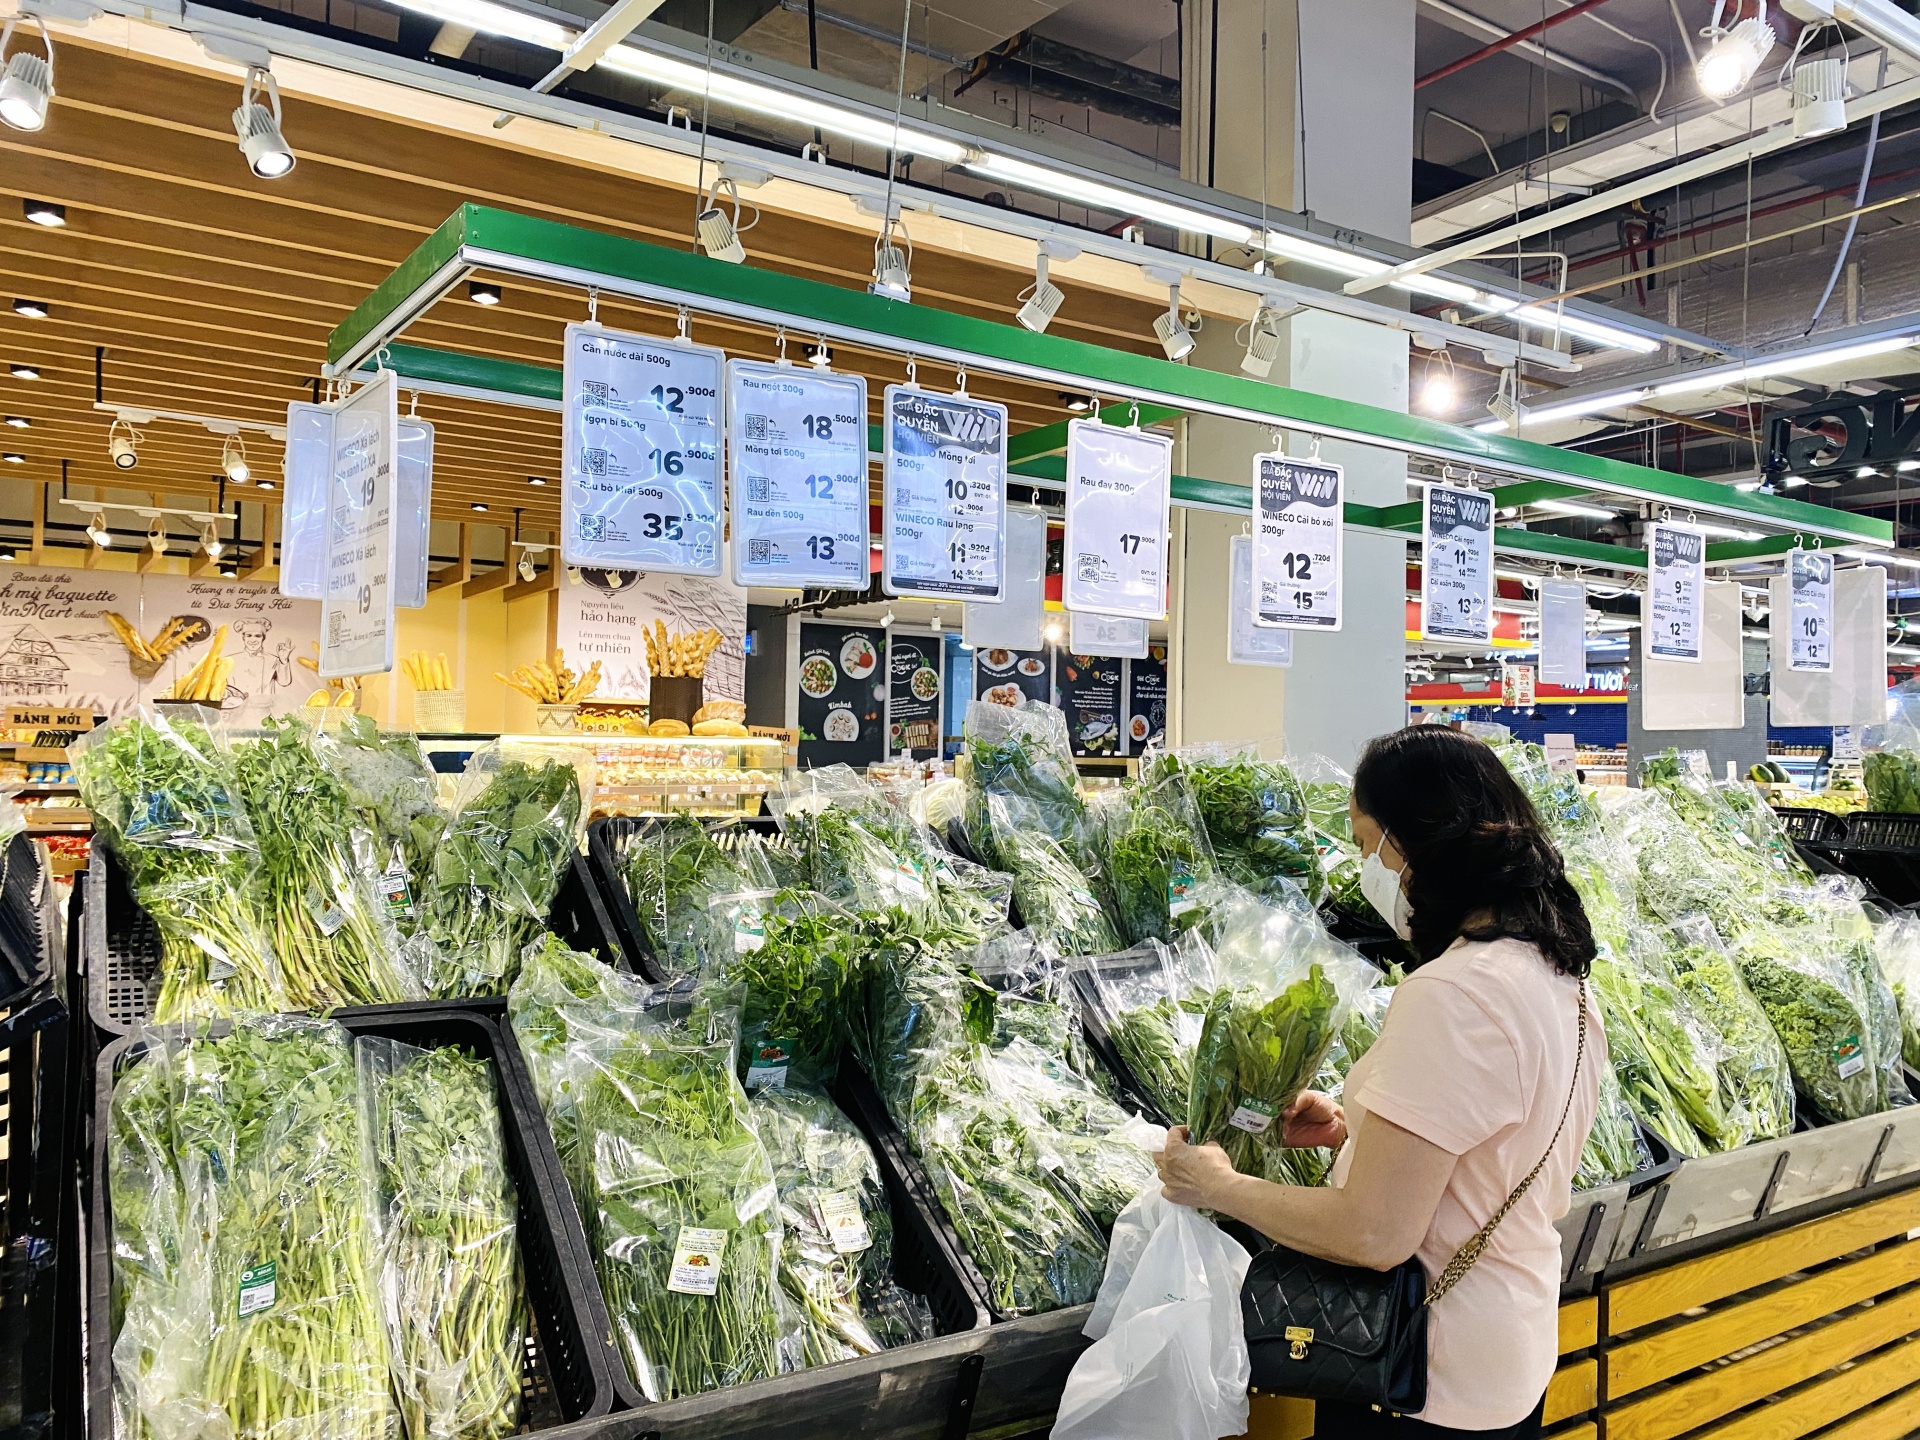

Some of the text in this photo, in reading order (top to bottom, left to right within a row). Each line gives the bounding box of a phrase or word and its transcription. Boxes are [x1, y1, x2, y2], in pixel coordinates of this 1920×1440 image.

[582, 343, 671, 368] Cần nước dài 500g
[743, 379, 804, 396] Rau ngót 300g
[610, 417, 618, 426] bí
[621, 419, 646, 431] 500g
[745, 443, 769, 456] Mồng
[783, 448, 805, 459] 500g
[938, 449, 963, 464] Mồng
[897, 458, 925, 471] 500gr
[1080, 476, 1096, 487] Rau
[1114, 482, 1135, 495] 300g
[1261, 476, 1292, 491] QUYỀN
[638, 488, 663, 500] 500g
[1261, 490, 1291, 501] HỘI VIÊN
[747, 508, 804, 521] Rau dền 500g
[895, 512, 974, 532] WINECO Rau lang
[1262, 511, 1295, 523] WINECO
[1296, 514, 1309, 524] Cải
[1322, 518, 1334, 527] xôi
[895, 527, 923, 540] 500gr
[1261, 524, 1285, 537] 300gr
[331, 550, 355, 569] WINECO
[364, 543, 377, 559] lách
[45, 584, 118, 605] baguette
[234, 597, 266, 612] Trung
[581, 600, 609, 609] Nguyên
[581, 609, 637, 626] hảo hạng
[578, 630, 631, 641] Lên men chua
[579, 641, 631, 654] tự nhiên
[13, 711, 81, 725] BÁNH MỚI
